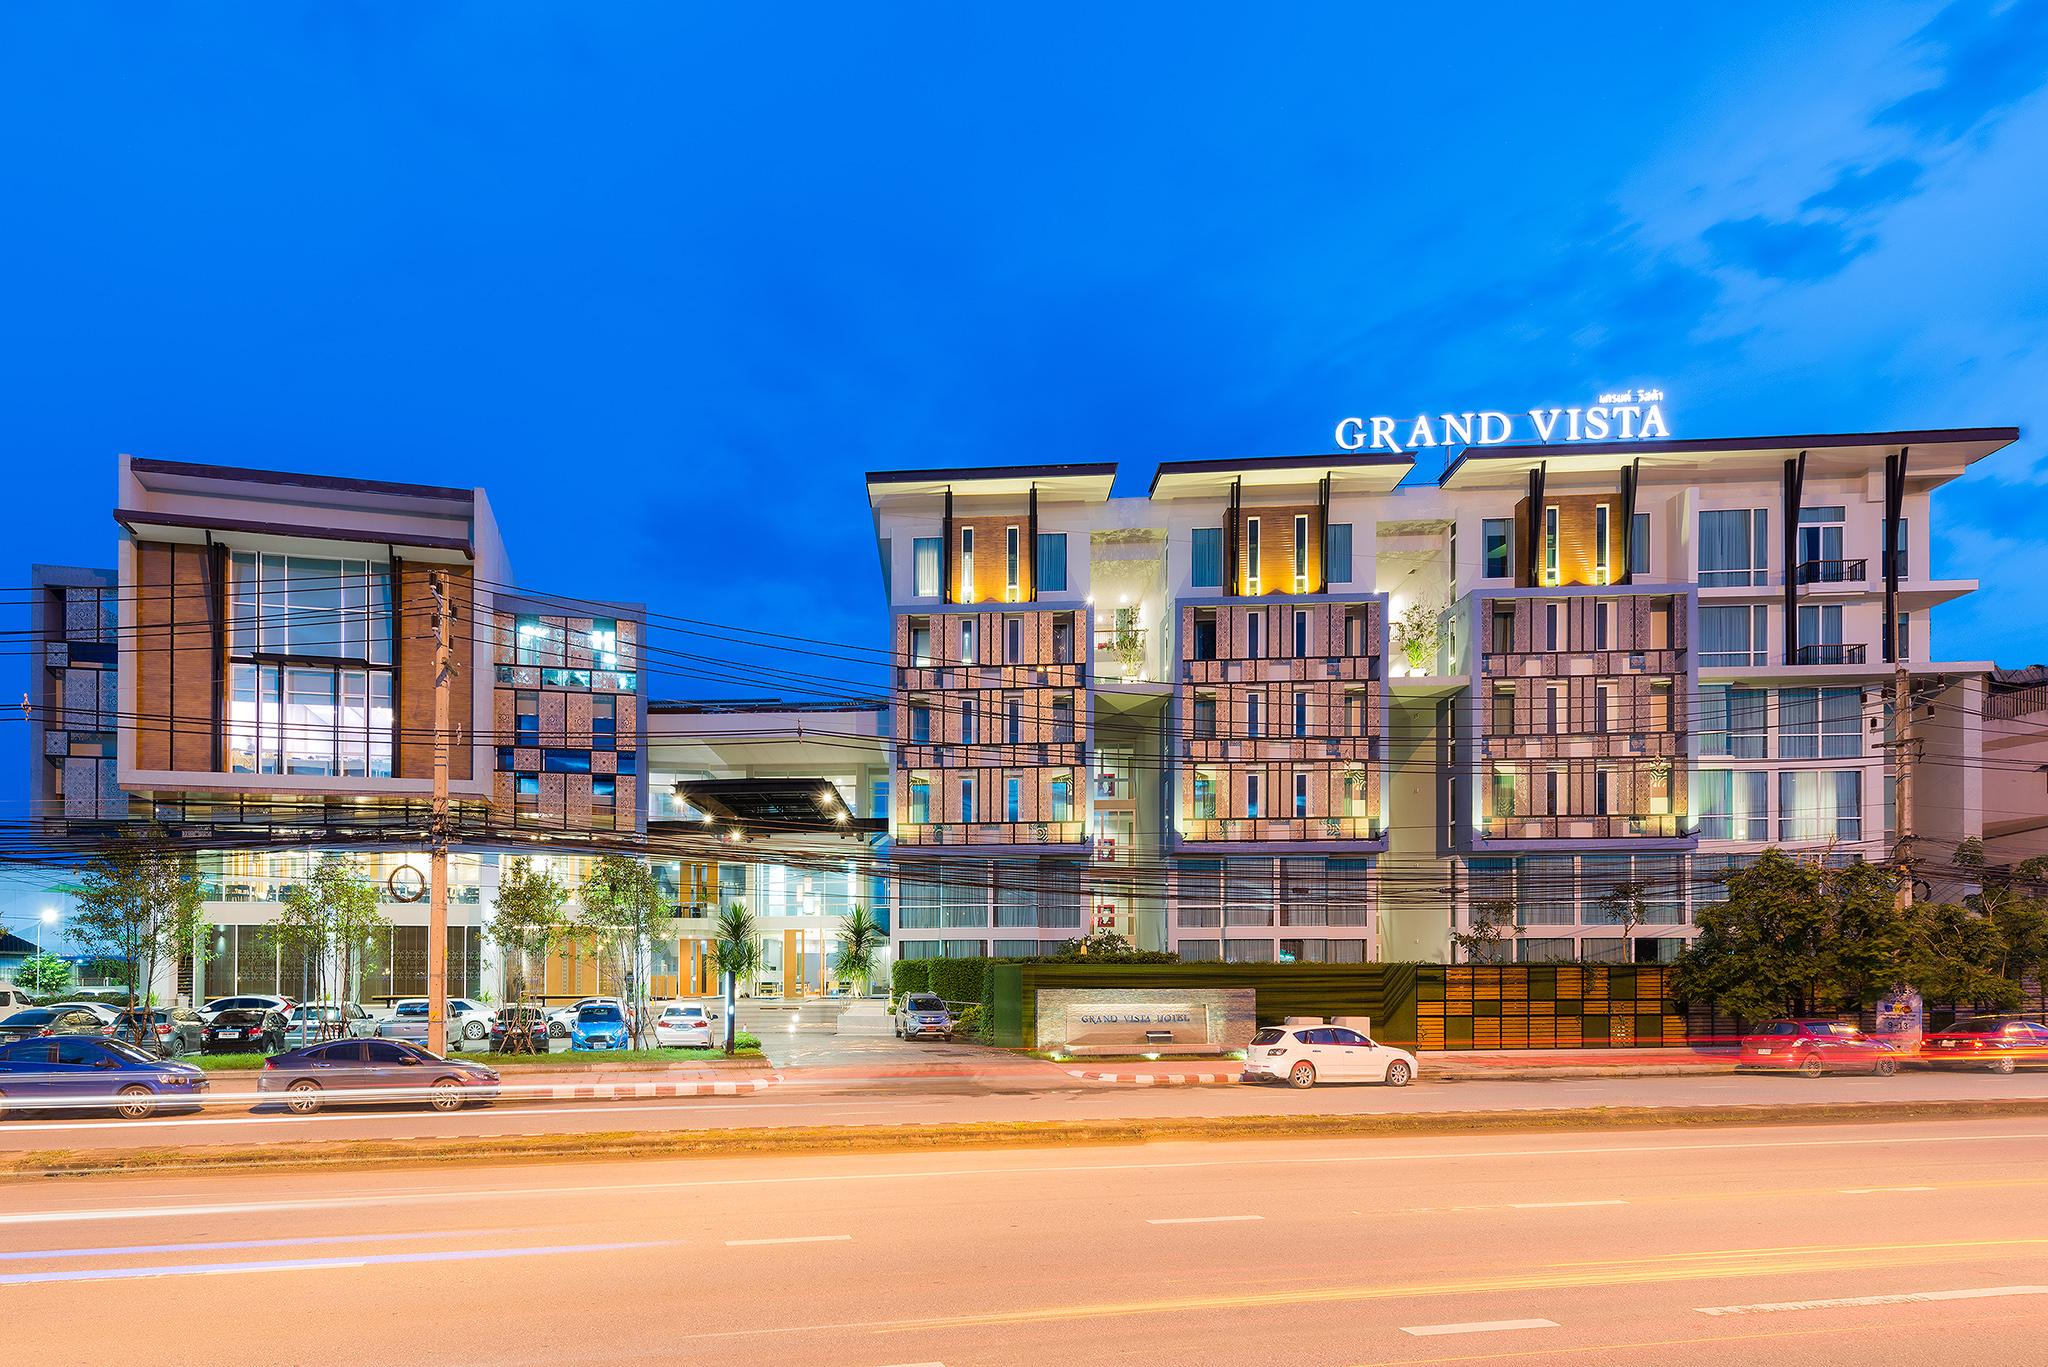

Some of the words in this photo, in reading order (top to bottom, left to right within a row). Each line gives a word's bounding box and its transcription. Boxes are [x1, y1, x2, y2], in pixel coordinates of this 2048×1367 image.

[1335, 411, 1512, 453] GRAND
[1529, 404, 1670, 442] VISTA
[1081, 1015, 1118, 1024] GRAND
[1124, 1015, 1151, 1023] VISTA
[1157, 1014, 1190, 1023] HOTEL
